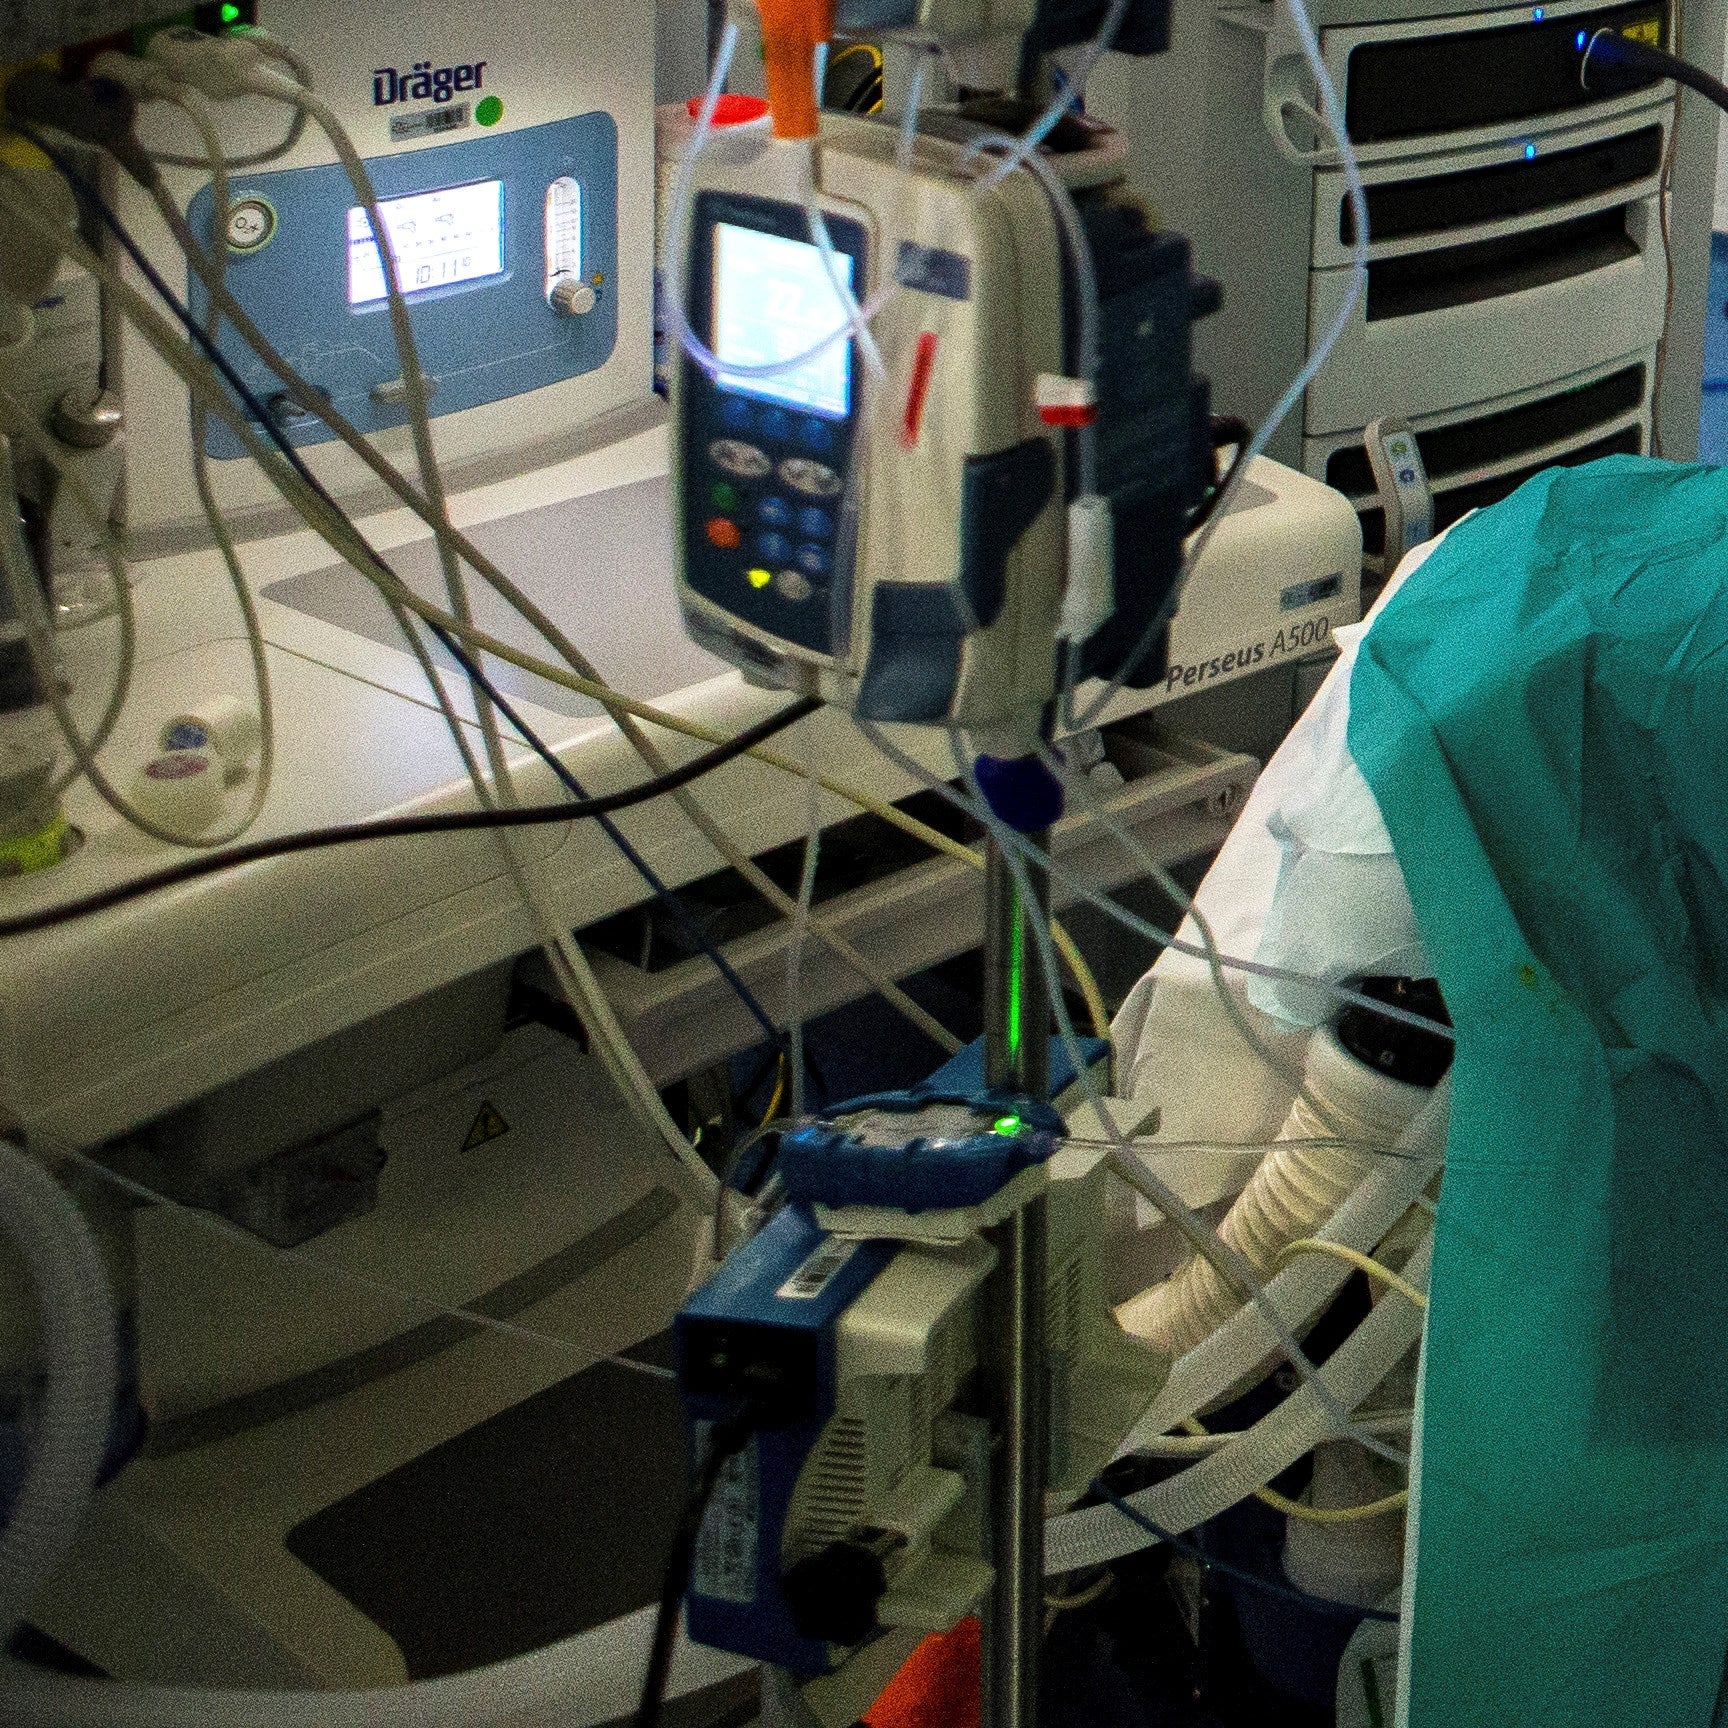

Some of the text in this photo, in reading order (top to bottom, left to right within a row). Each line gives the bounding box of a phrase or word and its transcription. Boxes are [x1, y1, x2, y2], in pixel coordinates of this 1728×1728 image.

[373, 60, 488, 106] Dräger
[1165, 617, 1329, 692] Perseus A500
